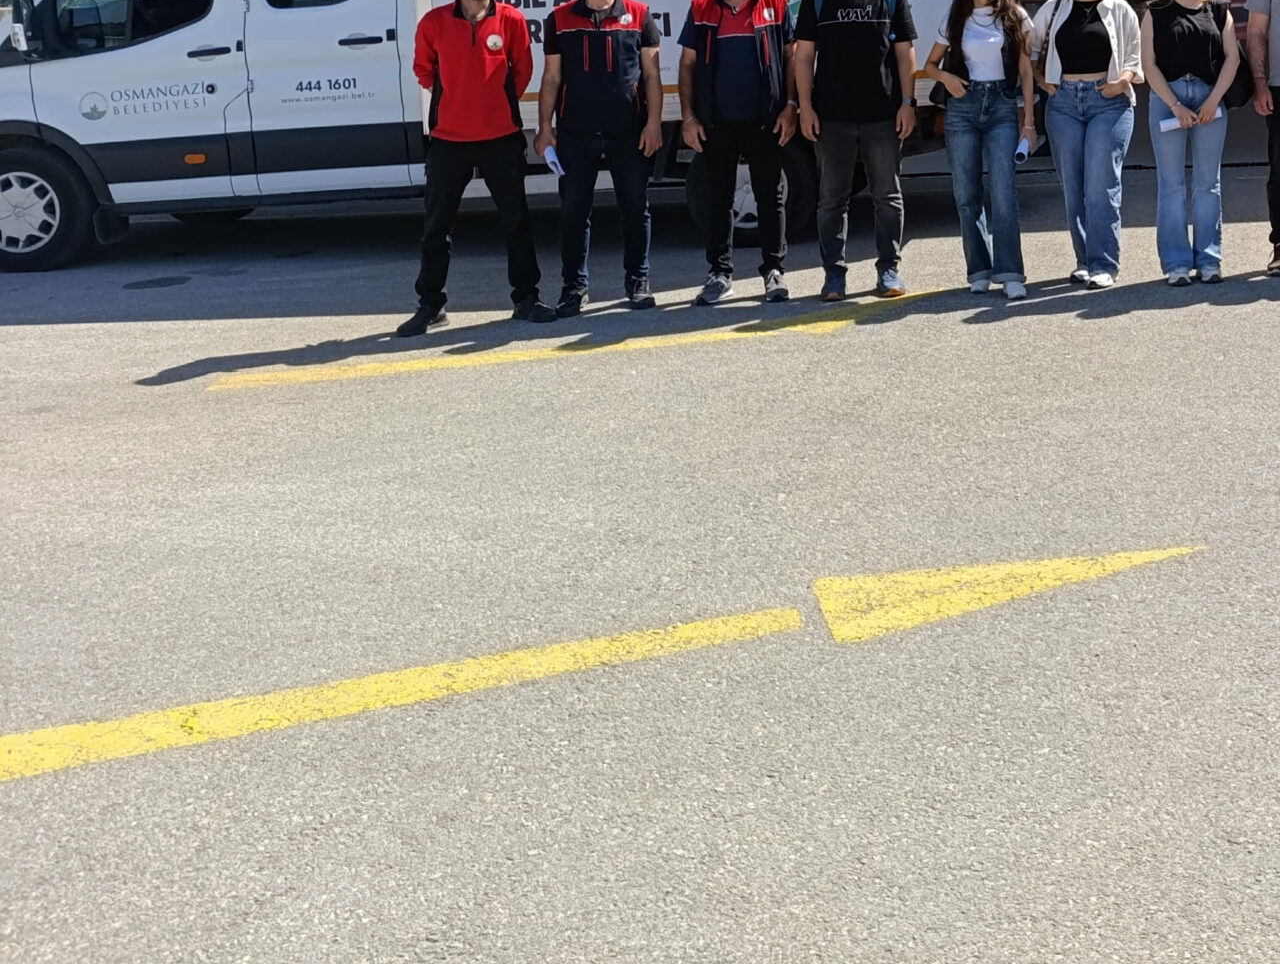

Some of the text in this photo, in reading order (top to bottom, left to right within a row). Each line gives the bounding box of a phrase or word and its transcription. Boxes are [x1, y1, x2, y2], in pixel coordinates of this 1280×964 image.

[110, 81, 206, 103] OSMANGAZİ
[295, 78, 358, 93] 444 1601
[112, 96, 207, 117] BELEDİYESİ
